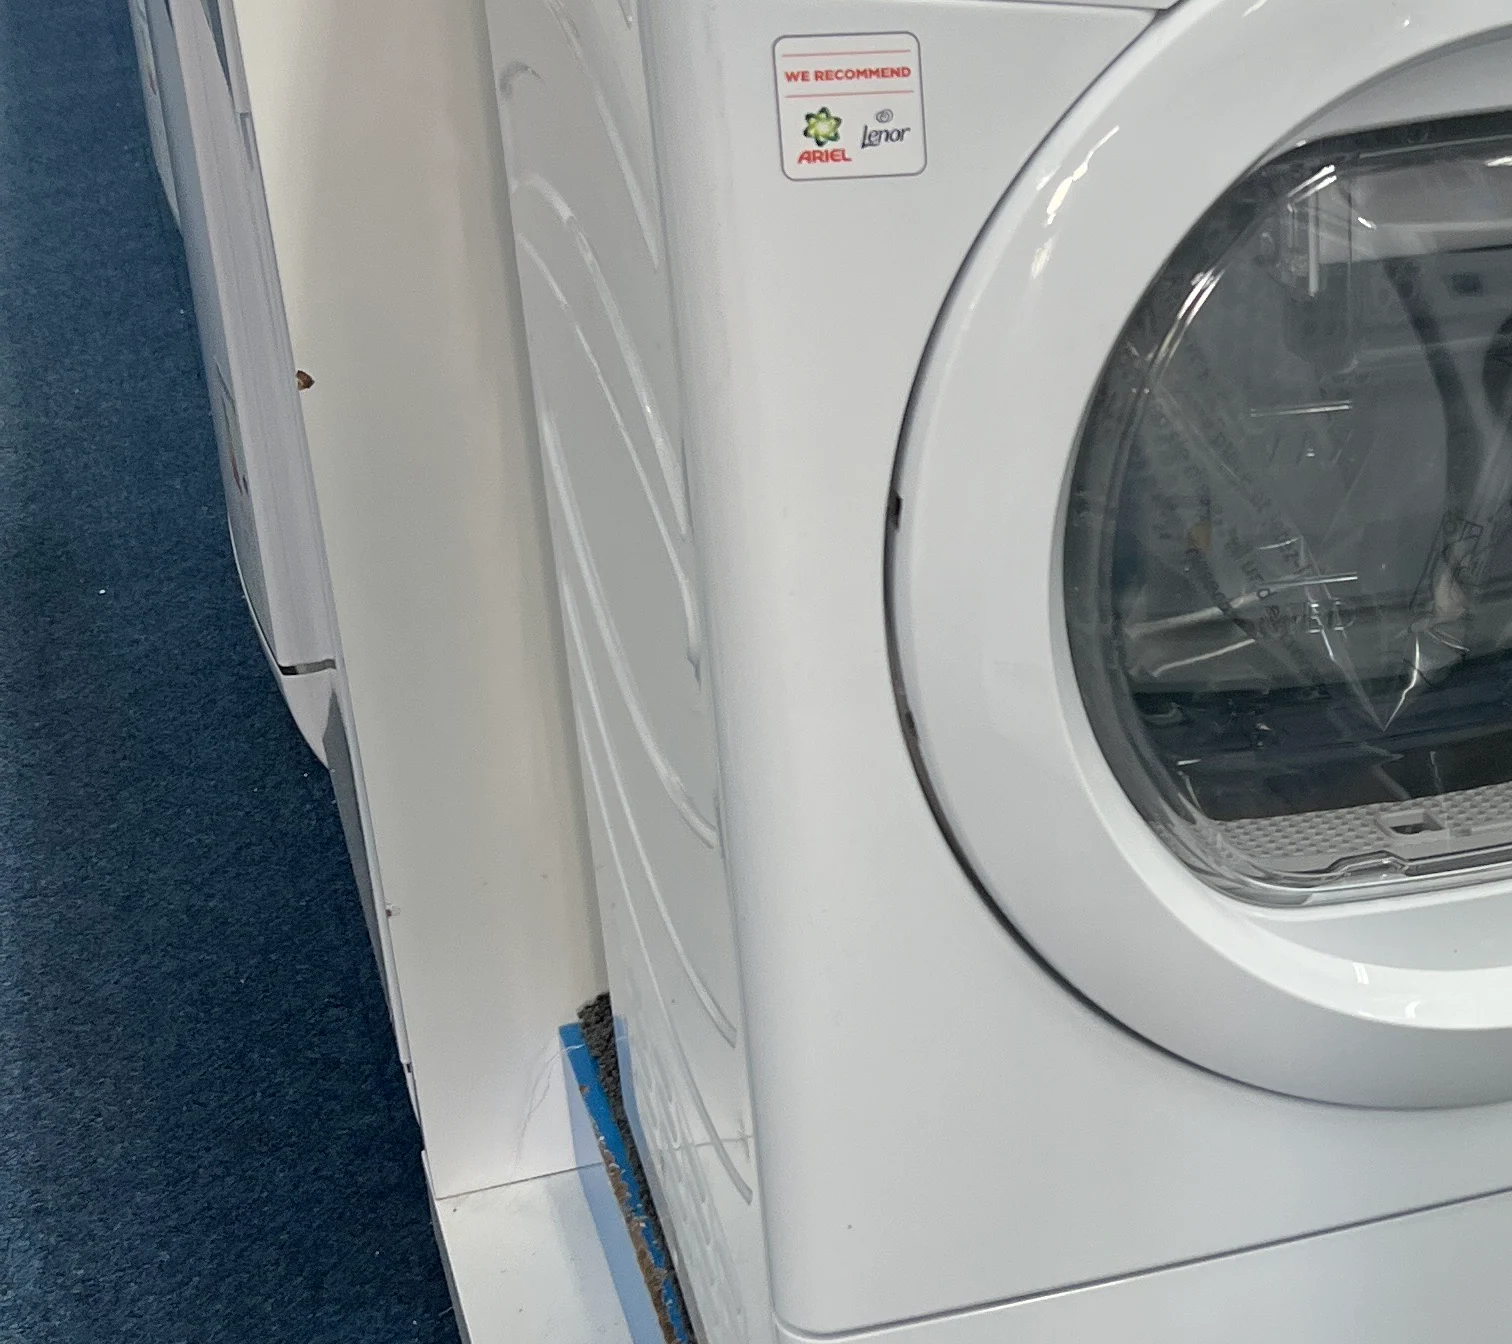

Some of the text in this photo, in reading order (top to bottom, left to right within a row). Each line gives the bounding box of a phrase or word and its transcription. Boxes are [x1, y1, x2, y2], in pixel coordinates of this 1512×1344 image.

[784, 66, 912, 82] WE RECOMMEND
[861, 124, 911, 149] Lenor
[797, 148, 852, 164] ARIEL
